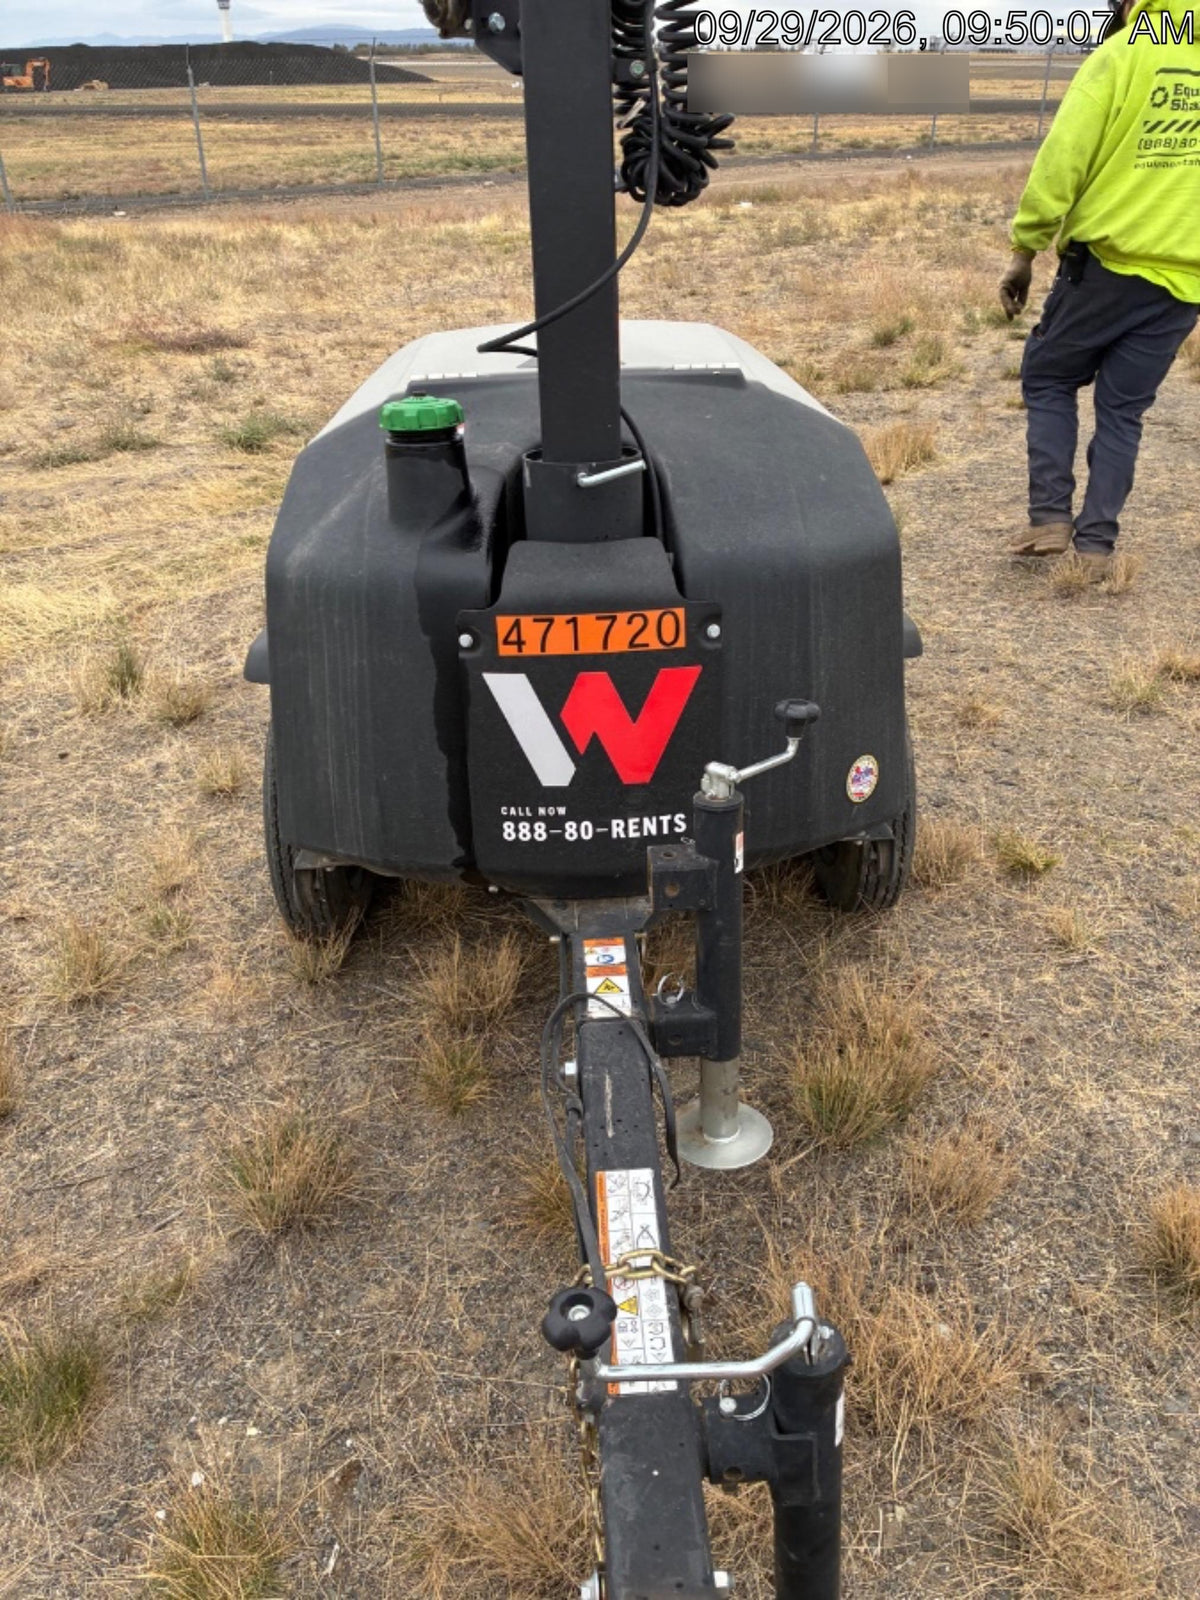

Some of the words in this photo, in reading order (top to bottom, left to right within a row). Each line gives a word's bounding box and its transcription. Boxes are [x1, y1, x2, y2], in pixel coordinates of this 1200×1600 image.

[502, 610, 681, 653] 471720
[501, 806, 532, 816] CALL
[538, 806, 567, 816] NOW
[502, 813, 687, 842] 888-80-RENTS
